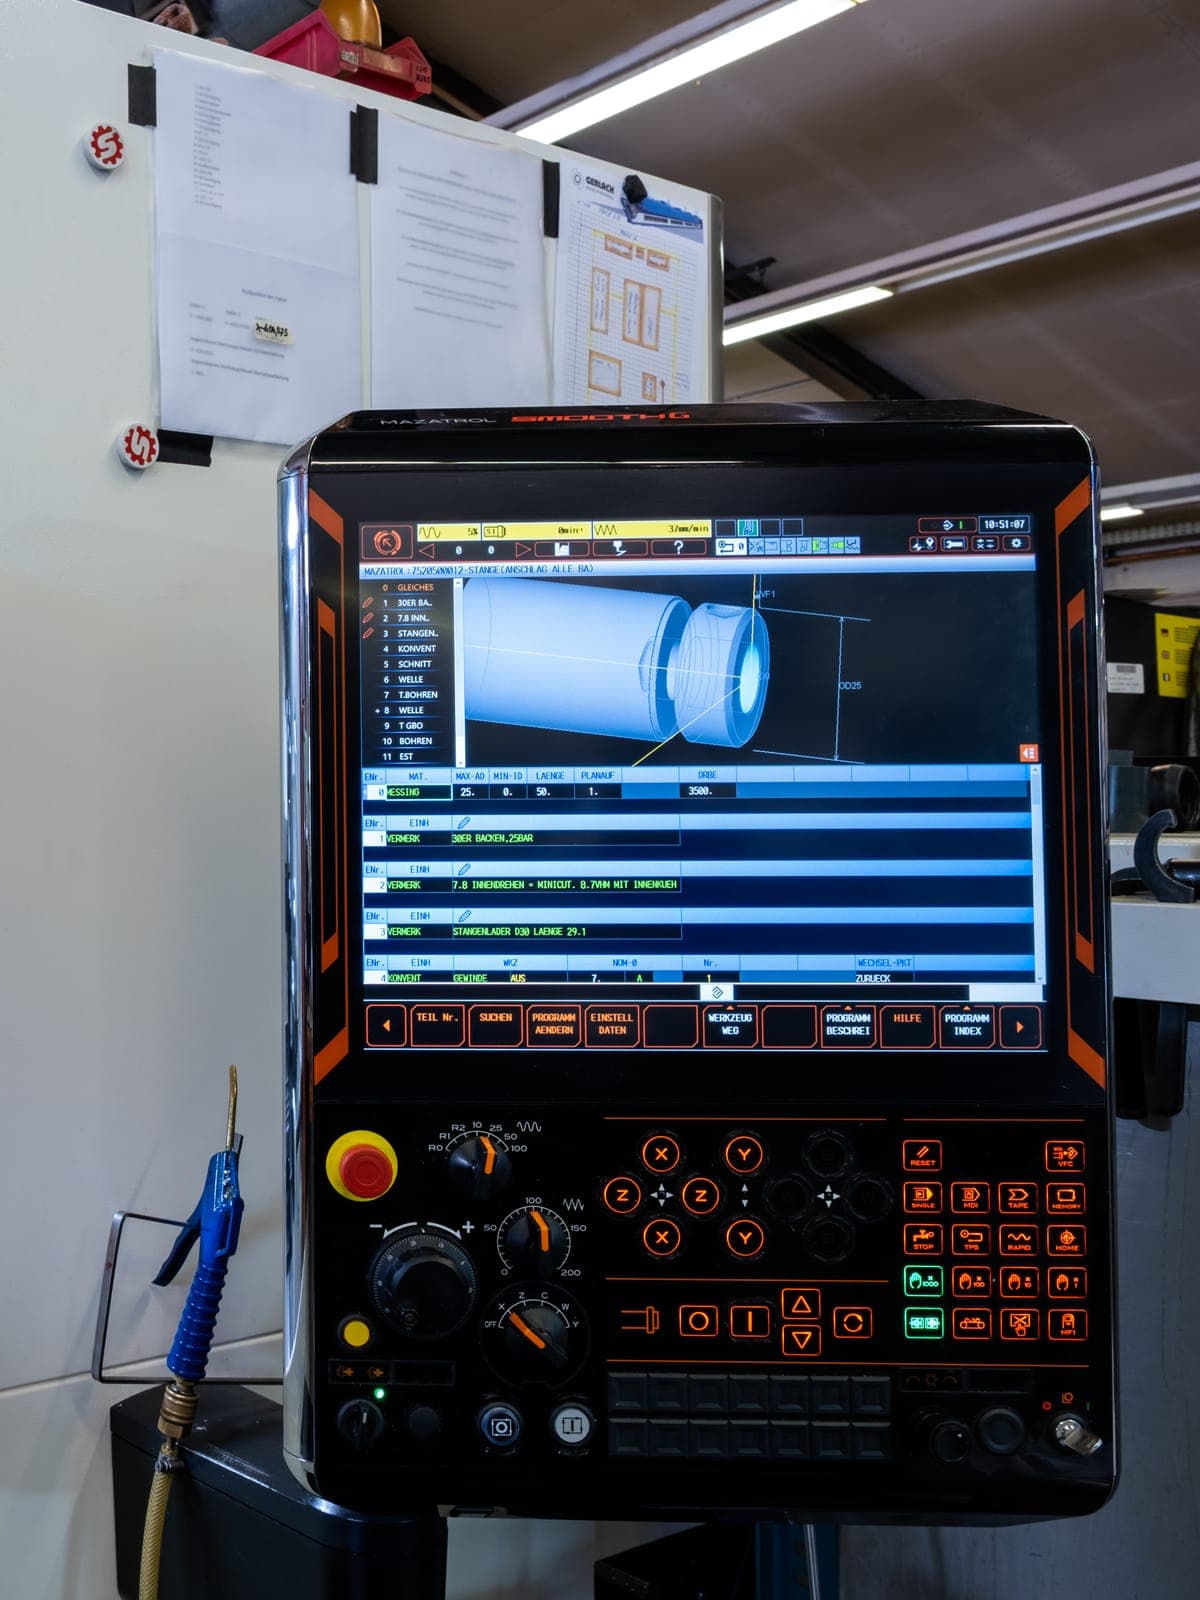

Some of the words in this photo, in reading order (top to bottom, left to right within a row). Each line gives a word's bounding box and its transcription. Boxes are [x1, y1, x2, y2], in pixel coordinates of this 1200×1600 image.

[585, 176, 615, 194] GERLACH
[380, 417, 497, 425] MAZATROL
[984, 519, 1025, 530] 10:51:07
[552, 564, 573, 574] ALLE
[382, 584, 389, 592] 0
[397, 583, 434, 592] GLEICHES
[383, 599, 388, 607] 1
[397, 599, 417, 607] 30ER
[397, 614, 410, 622] 7.8
[383, 645, 389, 653] 4
[398, 645, 437, 653] KONVENT
[398, 660, 432, 668] SCHNITT
[383, 676, 389, 684] 6
[398, 676, 424, 684] WELLE
[839, 681, 862, 690] OD25
[383, 691, 389, 699] 7
[398, 691, 438, 699] T.BOHREN
[384, 722, 390, 730] 9
[399, 722, 405, 730] T
[405, 722, 424, 730] GBO
[382, 737, 392, 745] 10
[399, 737, 433, 745] BOHREN
[382, 753, 392, 761] 11
[399, 752, 414, 761] EST
[364, 773, 383, 781] ENr.
[408, 772, 428, 781] MAT.
[455, 772, 485, 780] MAX-AD
[493, 772, 523, 780] MIN-ID
[535, 771, 566, 780] LAENGE
[581, 771, 616, 780] PLANAUF
[460, 787, 475, 797] 25.
[502, 787, 513, 797] 0.
[536, 787, 551, 796] 50.
[589, 787, 599, 796] 1.
[688, 786, 713, 796] 3500.
[364, 819, 383, 828] ENr.
[409, 819, 429, 828] EINH
[386, 834, 421, 843] VERMERK
[451, 834, 472, 843] 30ER
[365, 866, 384, 874] ENr.
[410, 865, 430, 874] EINH
[387, 881, 421, 890] VERMERK
[453, 880, 468, 890] 7.8
[472, 880, 525, 889] INNENDREHEN
[613, 880, 629, 889] MIT
[634, 880, 678, 889] INNENKUEH
[366, 912, 385, 920] ENr.
[410, 911, 431, 920] EINH
[387, 927, 422, 936] VERMERK
[452, 927, 511, 936] STANGENLADER
[514, 927, 530, 936] D30
[533, 927, 563, 936] LAENGE
[567, 927, 586, 936] 29.1
[366, 959, 385, 967] ENr.
[411, 959, 431, 967] EINH
[503, 959, 519, 967] WKZ
[703, 959, 718, 967] Nr.
[857, 958, 912, 967] WECHSEL-PKT
[387, 974, 422, 983] KONVENT
[453, 974, 488, 983] GEWINDE
[510, 974, 527, 983] AUS
[855, 974, 891, 983] ZURUECK
[416, 1012, 439, 1022] TEIL
[442, 1012, 459, 1022] Nr.
[479, 1012, 513, 1022] SUCHEN
[532, 1013, 576, 1022] PROGRAMM
[590, 1013, 634, 1022] EINSTELL
[708, 1013, 753, 1023] WERKZEUG
[826, 1013, 871, 1023] PROGRAMM
[893, 1013, 922, 1023] HILFE
[945, 1013, 990, 1023] PROGRAMM
[535, 1026, 574, 1035] AENDERN
[599, 1026, 627, 1035] DATEN
[721, 1026, 739, 1036] WEG
[826, 1026, 870, 1036] BESCHREI
[954, 1026, 982, 1036] INDEX
[451, 1124, 466, 1132] R2
[472, 1121, 483, 1129] 10
[489, 1124, 503, 1132] 25
[439, 1132, 450, 1140] R1
[503, 1133, 518, 1141] 50
[655, 1147, 668, 1161] X
[737, 1147, 752, 1161] Y
[616, 1189, 629, 1202] Z
[695, 1190, 708, 1202] Z
[483, 1224, 498, 1232] 50
[570, 1224, 587, 1232] 150
[655, 1230, 669, 1244] X
[738, 1231, 753, 1245] Y
[1007, 1244, 1031, 1252] RAPID
[501, 1269, 509, 1277] 0
[560, 1269, 582, 1277] 200
[518, 1292, 526, 1300] Z
[540, 1291, 549, 1300] C
[498, 1303, 505, 1311] X
[561, 1303, 570, 1311] W
[484, 1320, 497, 1328] OFF
[571, 1320, 580, 1328] Y
